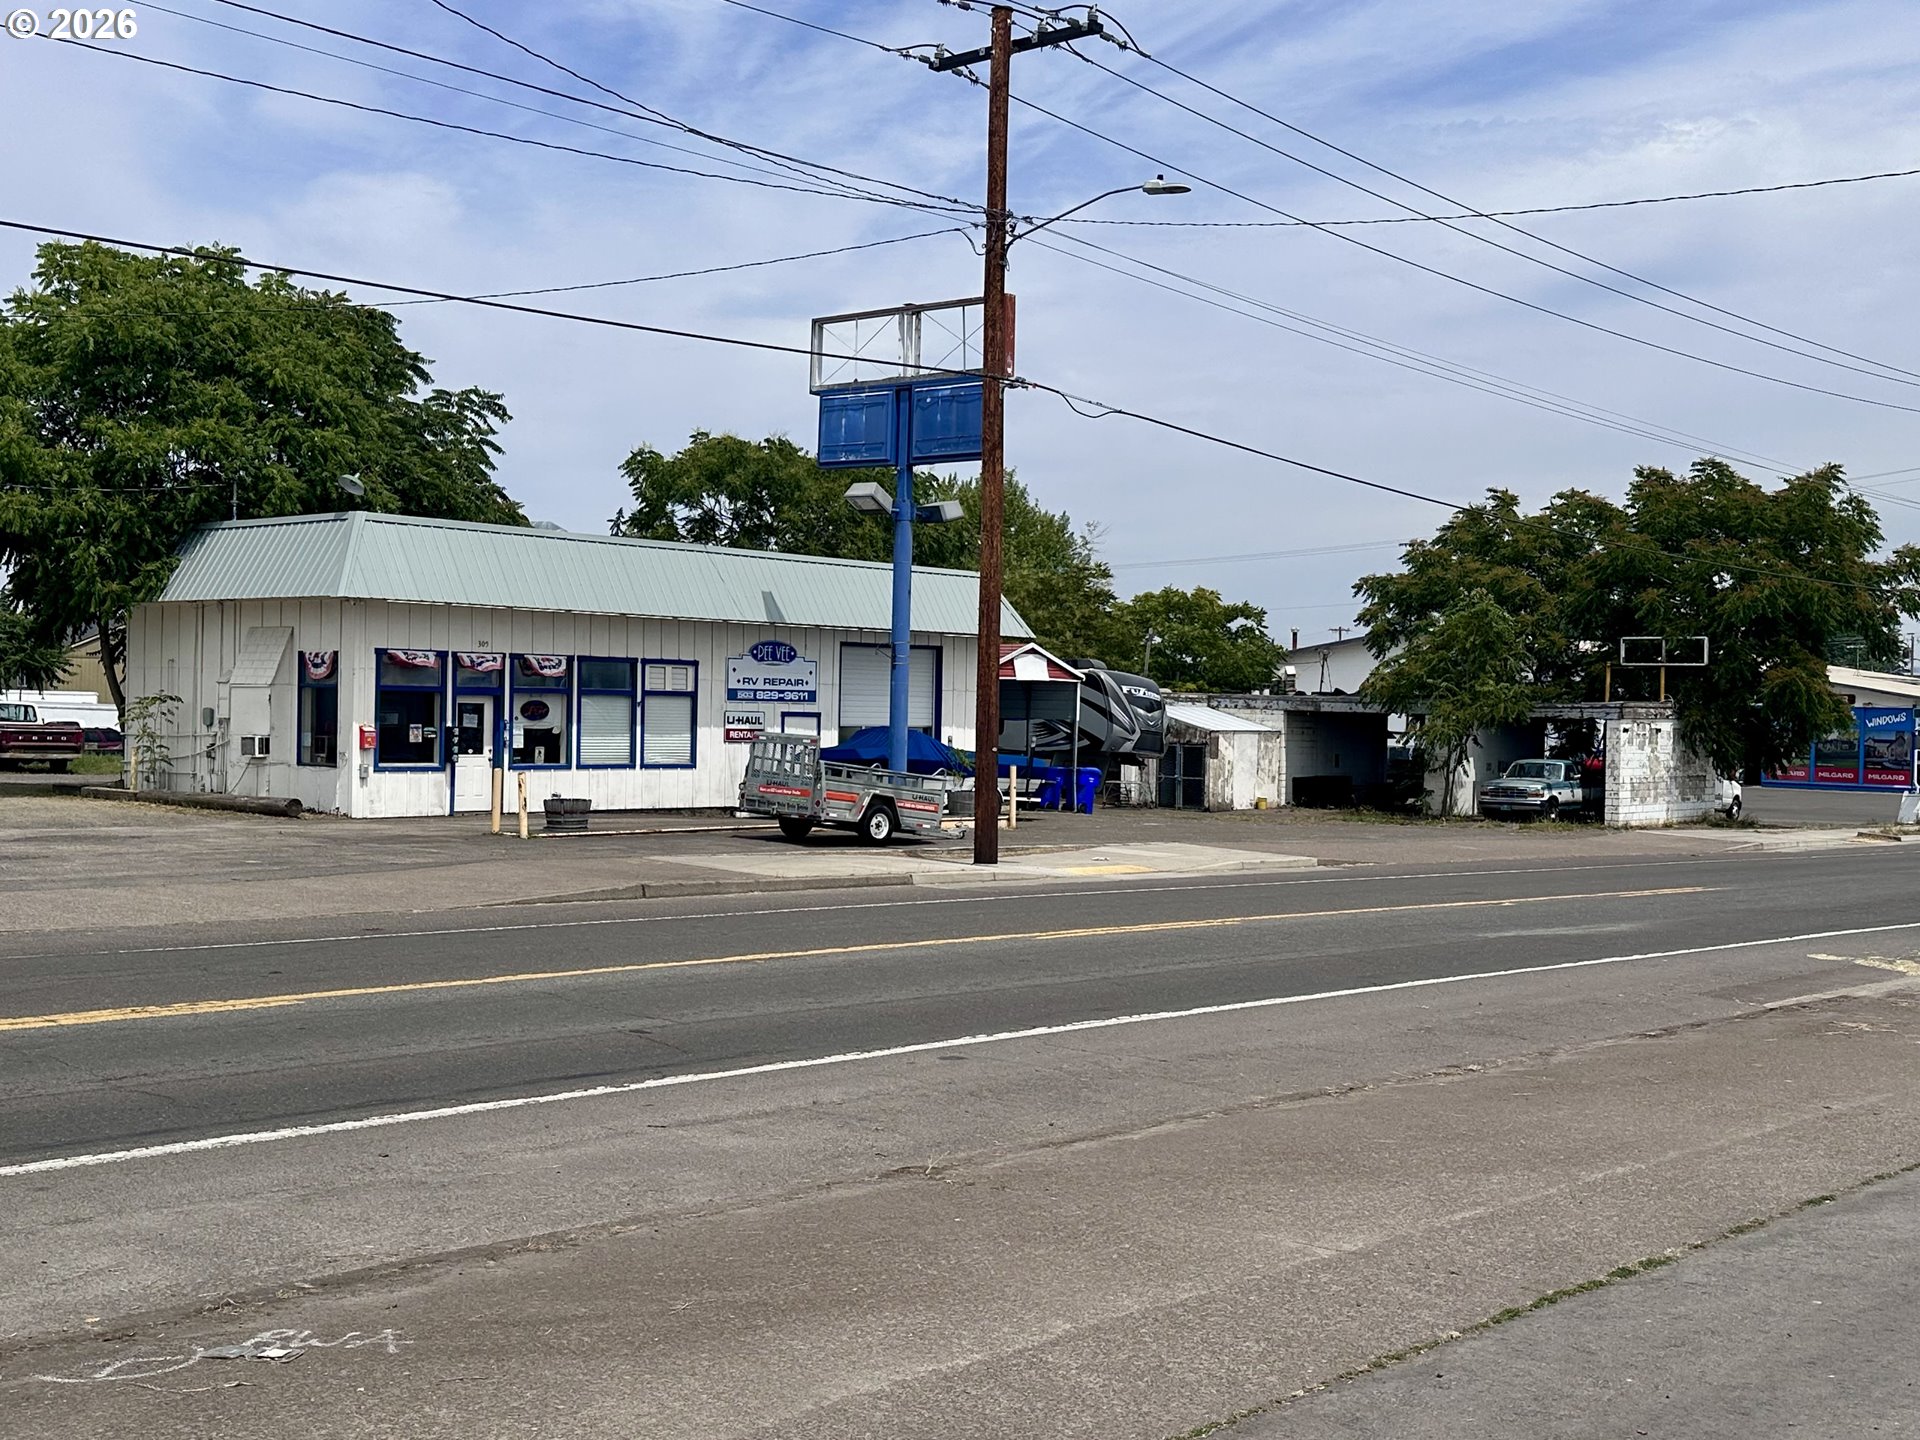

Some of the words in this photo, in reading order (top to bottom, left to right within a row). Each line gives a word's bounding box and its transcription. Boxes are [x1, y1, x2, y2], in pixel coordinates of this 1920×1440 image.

[757, 645, 773, 661] PEE
[775, 645, 791, 662] VEE
[742, 677, 759, 686] RV
[763, 677, 804, 687] REPAIR
[756, 691, 808, 700] 829-9611
[726, 715, 763, 725] U-HAUL
[1865, 712, 1907, 728] WINDOWS
[729, 730, 754, 739] RENTA
[1818, 771, 1854, 779] MILGARD
[1868, 773, 1905, 781] MILGARD
